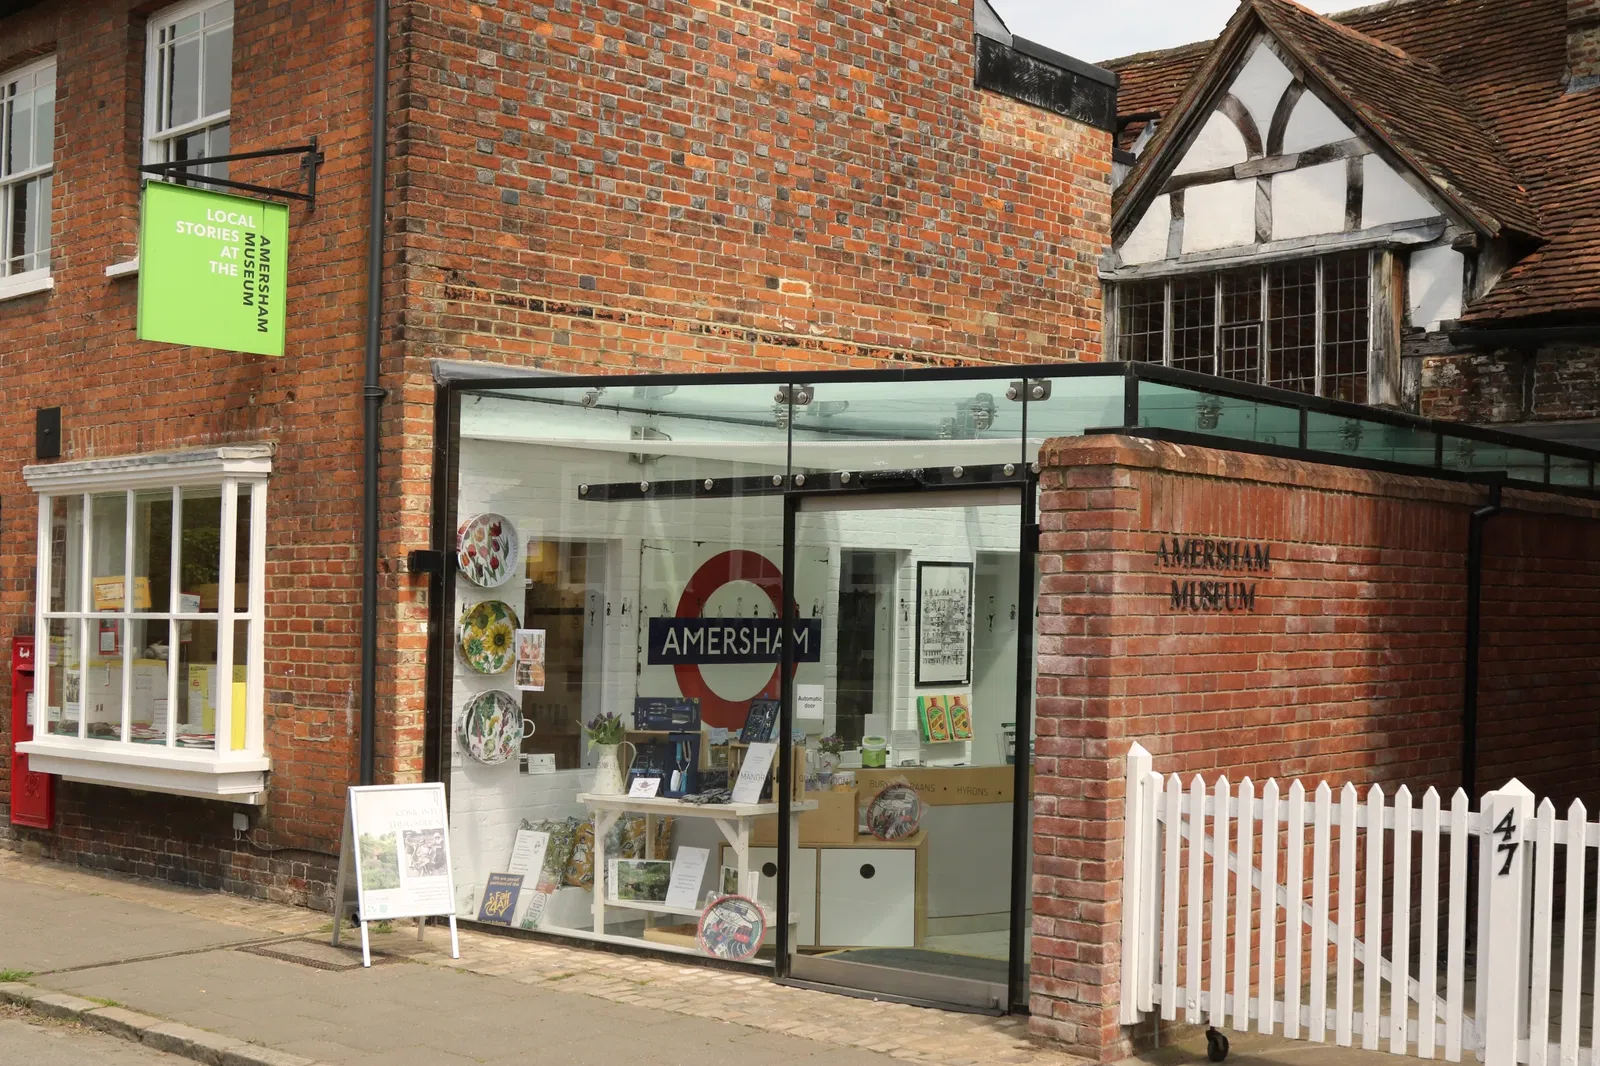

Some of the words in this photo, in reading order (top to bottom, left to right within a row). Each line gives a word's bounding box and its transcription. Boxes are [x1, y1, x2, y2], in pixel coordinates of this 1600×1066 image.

[207, 208, 256, 228] LOCAL
[175, 220, 240, 243] STORIES
[220, 246, 239, 259] AT
[209, 260, 239, 277] THE
[243, 231, 256, 306] MUSEUM
[257, 235, 271, 333] AMERSHAM
[1154, 537, 1271, 573] AMERSHAM
[1170, 580, 1256, 612] MUSEUM
[957, 785, 988, 797] HYRONS
[1492, 807, 1517, 876] 47
[495, 890, 512, 900] Fair
